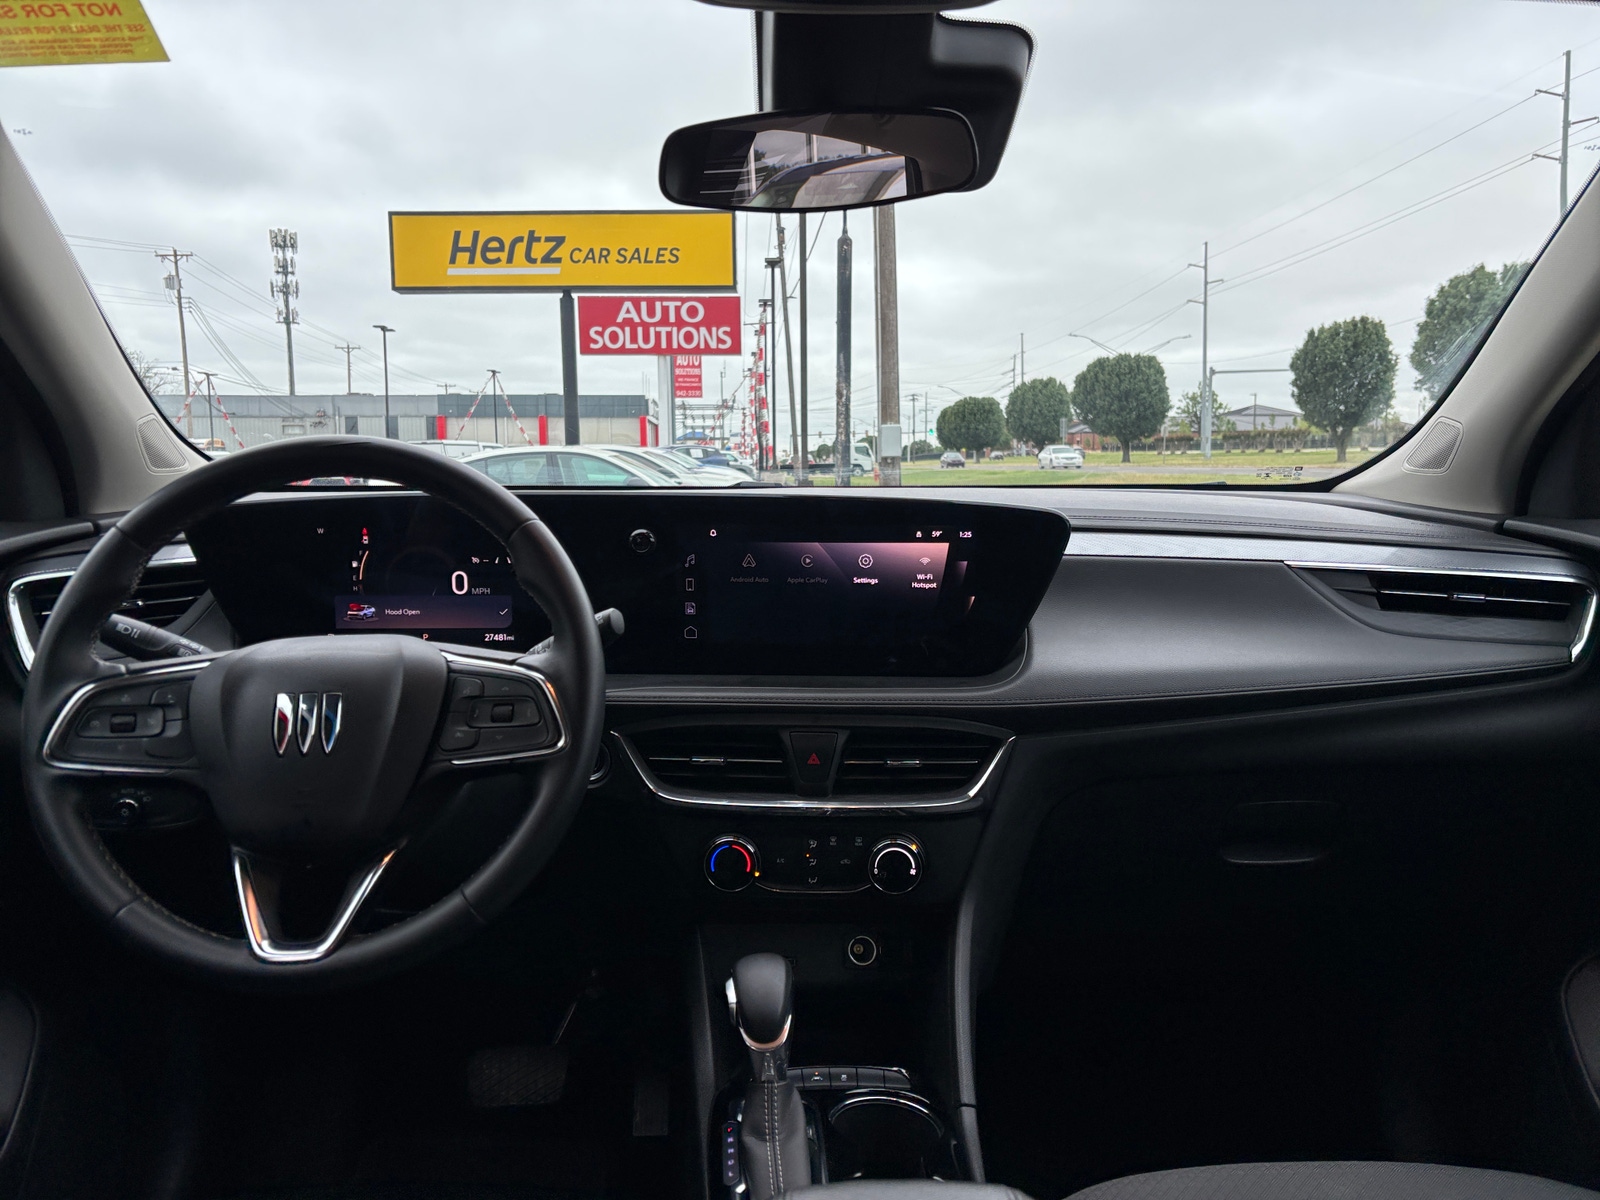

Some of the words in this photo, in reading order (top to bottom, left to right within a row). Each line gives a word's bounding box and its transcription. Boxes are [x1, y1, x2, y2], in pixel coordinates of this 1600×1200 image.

[448, 229, 567, 265] Hertz
[569, 247, 611, 264] CAR
[615, 247, 681, 264] SALES
[616, 300, 705, 323] AUTO
[589, 325, 733, 351] SOLUTIONS
[676, 355, 701, 366] AUTO
[451, 570, 469, 596] 0
[471, 587, 491, 595] MPH
[786, 576, 805, 585] Apple
[805, 576, 829, 585] CarPlay
[852, 576, 879, 585] Settings
[911, 582, 938, 590] Hotspot
[385, 608, 402, 616] Hood
[403, 608, 420, 616] Open
